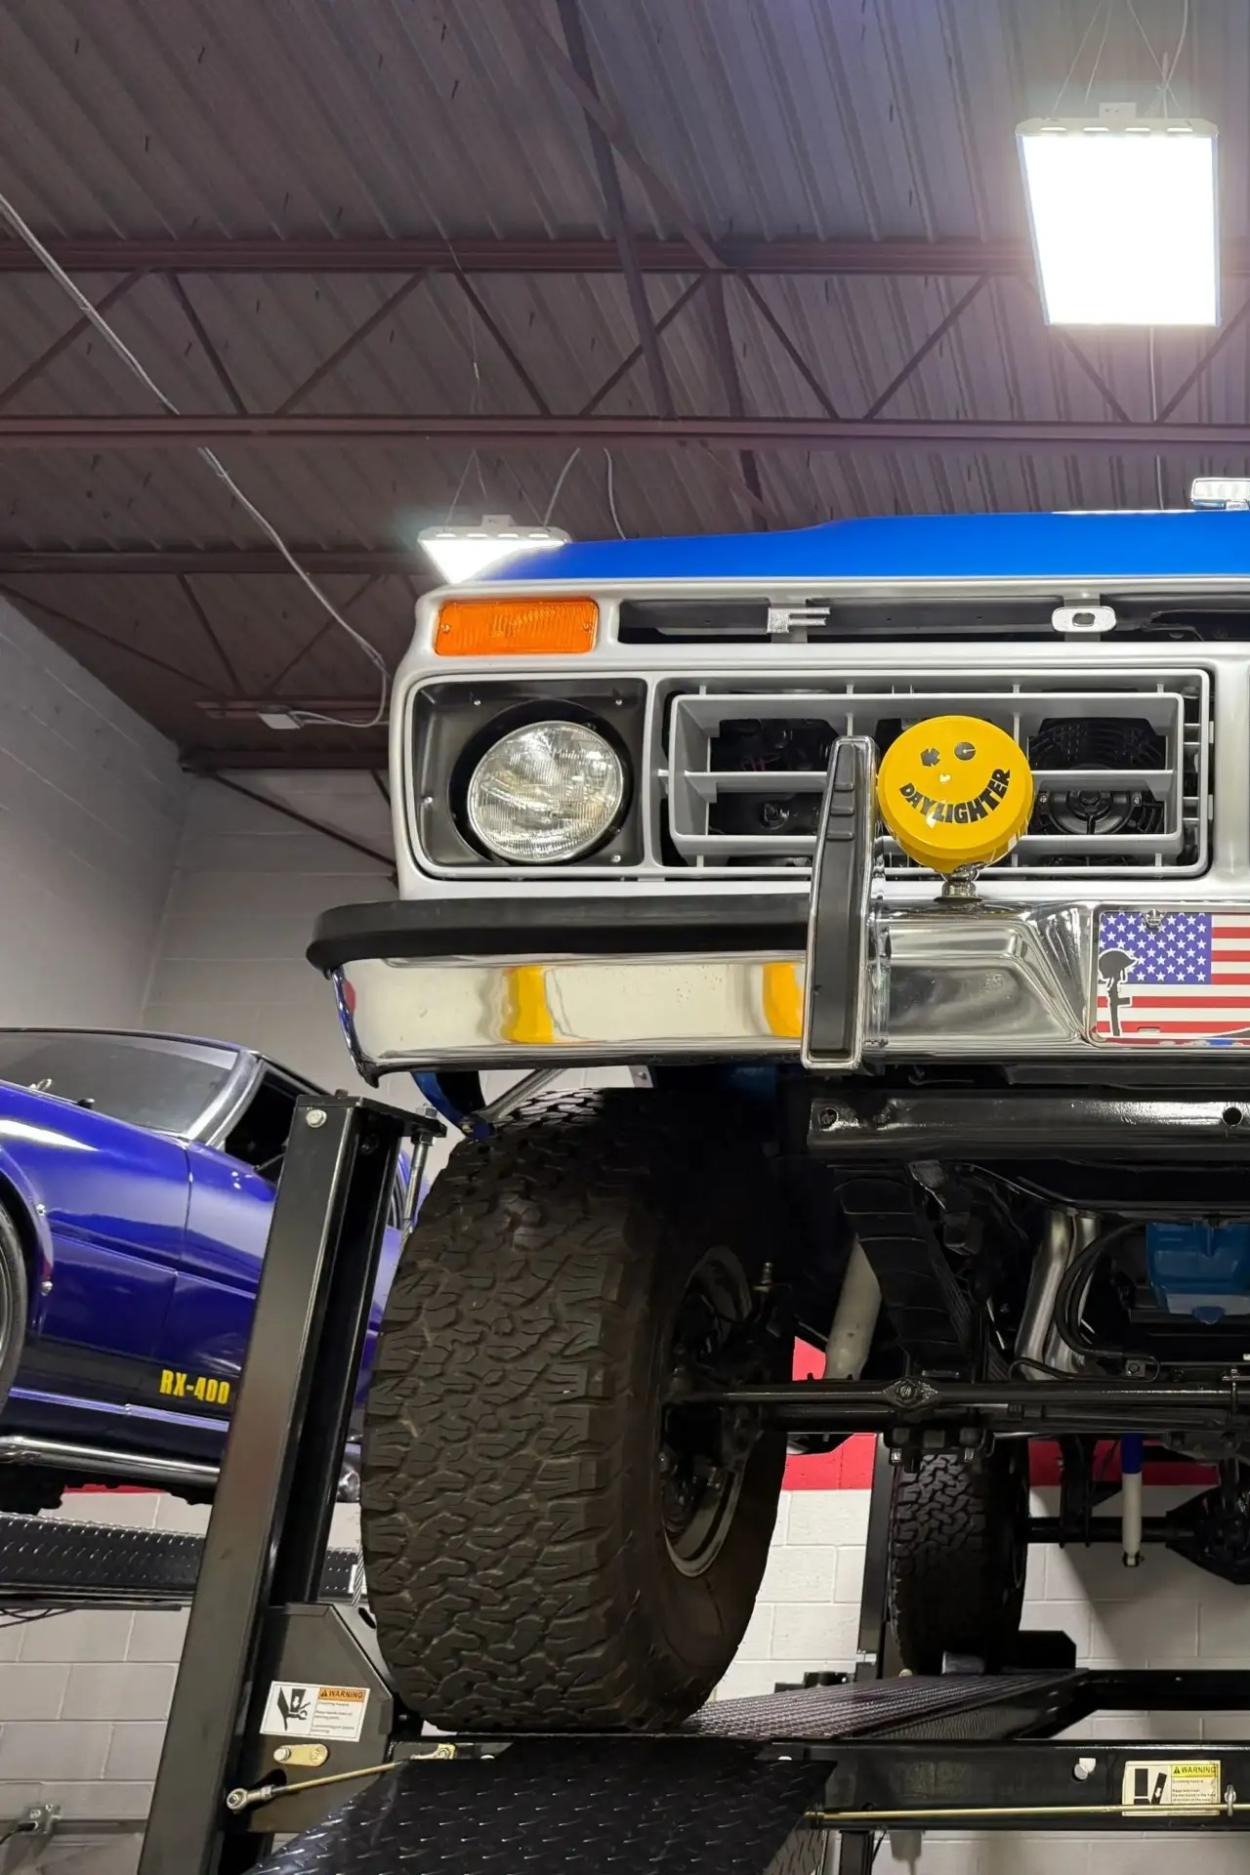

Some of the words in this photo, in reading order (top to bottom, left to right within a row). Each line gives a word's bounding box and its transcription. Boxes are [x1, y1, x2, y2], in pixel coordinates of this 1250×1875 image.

[898, 768, 1011, 824] DAYLIGHTER
[159, 1369, 231, 1405] RX-400
[328, 1689, 364, 1699] WARNING
[1180, 1766, 1217, 1774] WARNING
